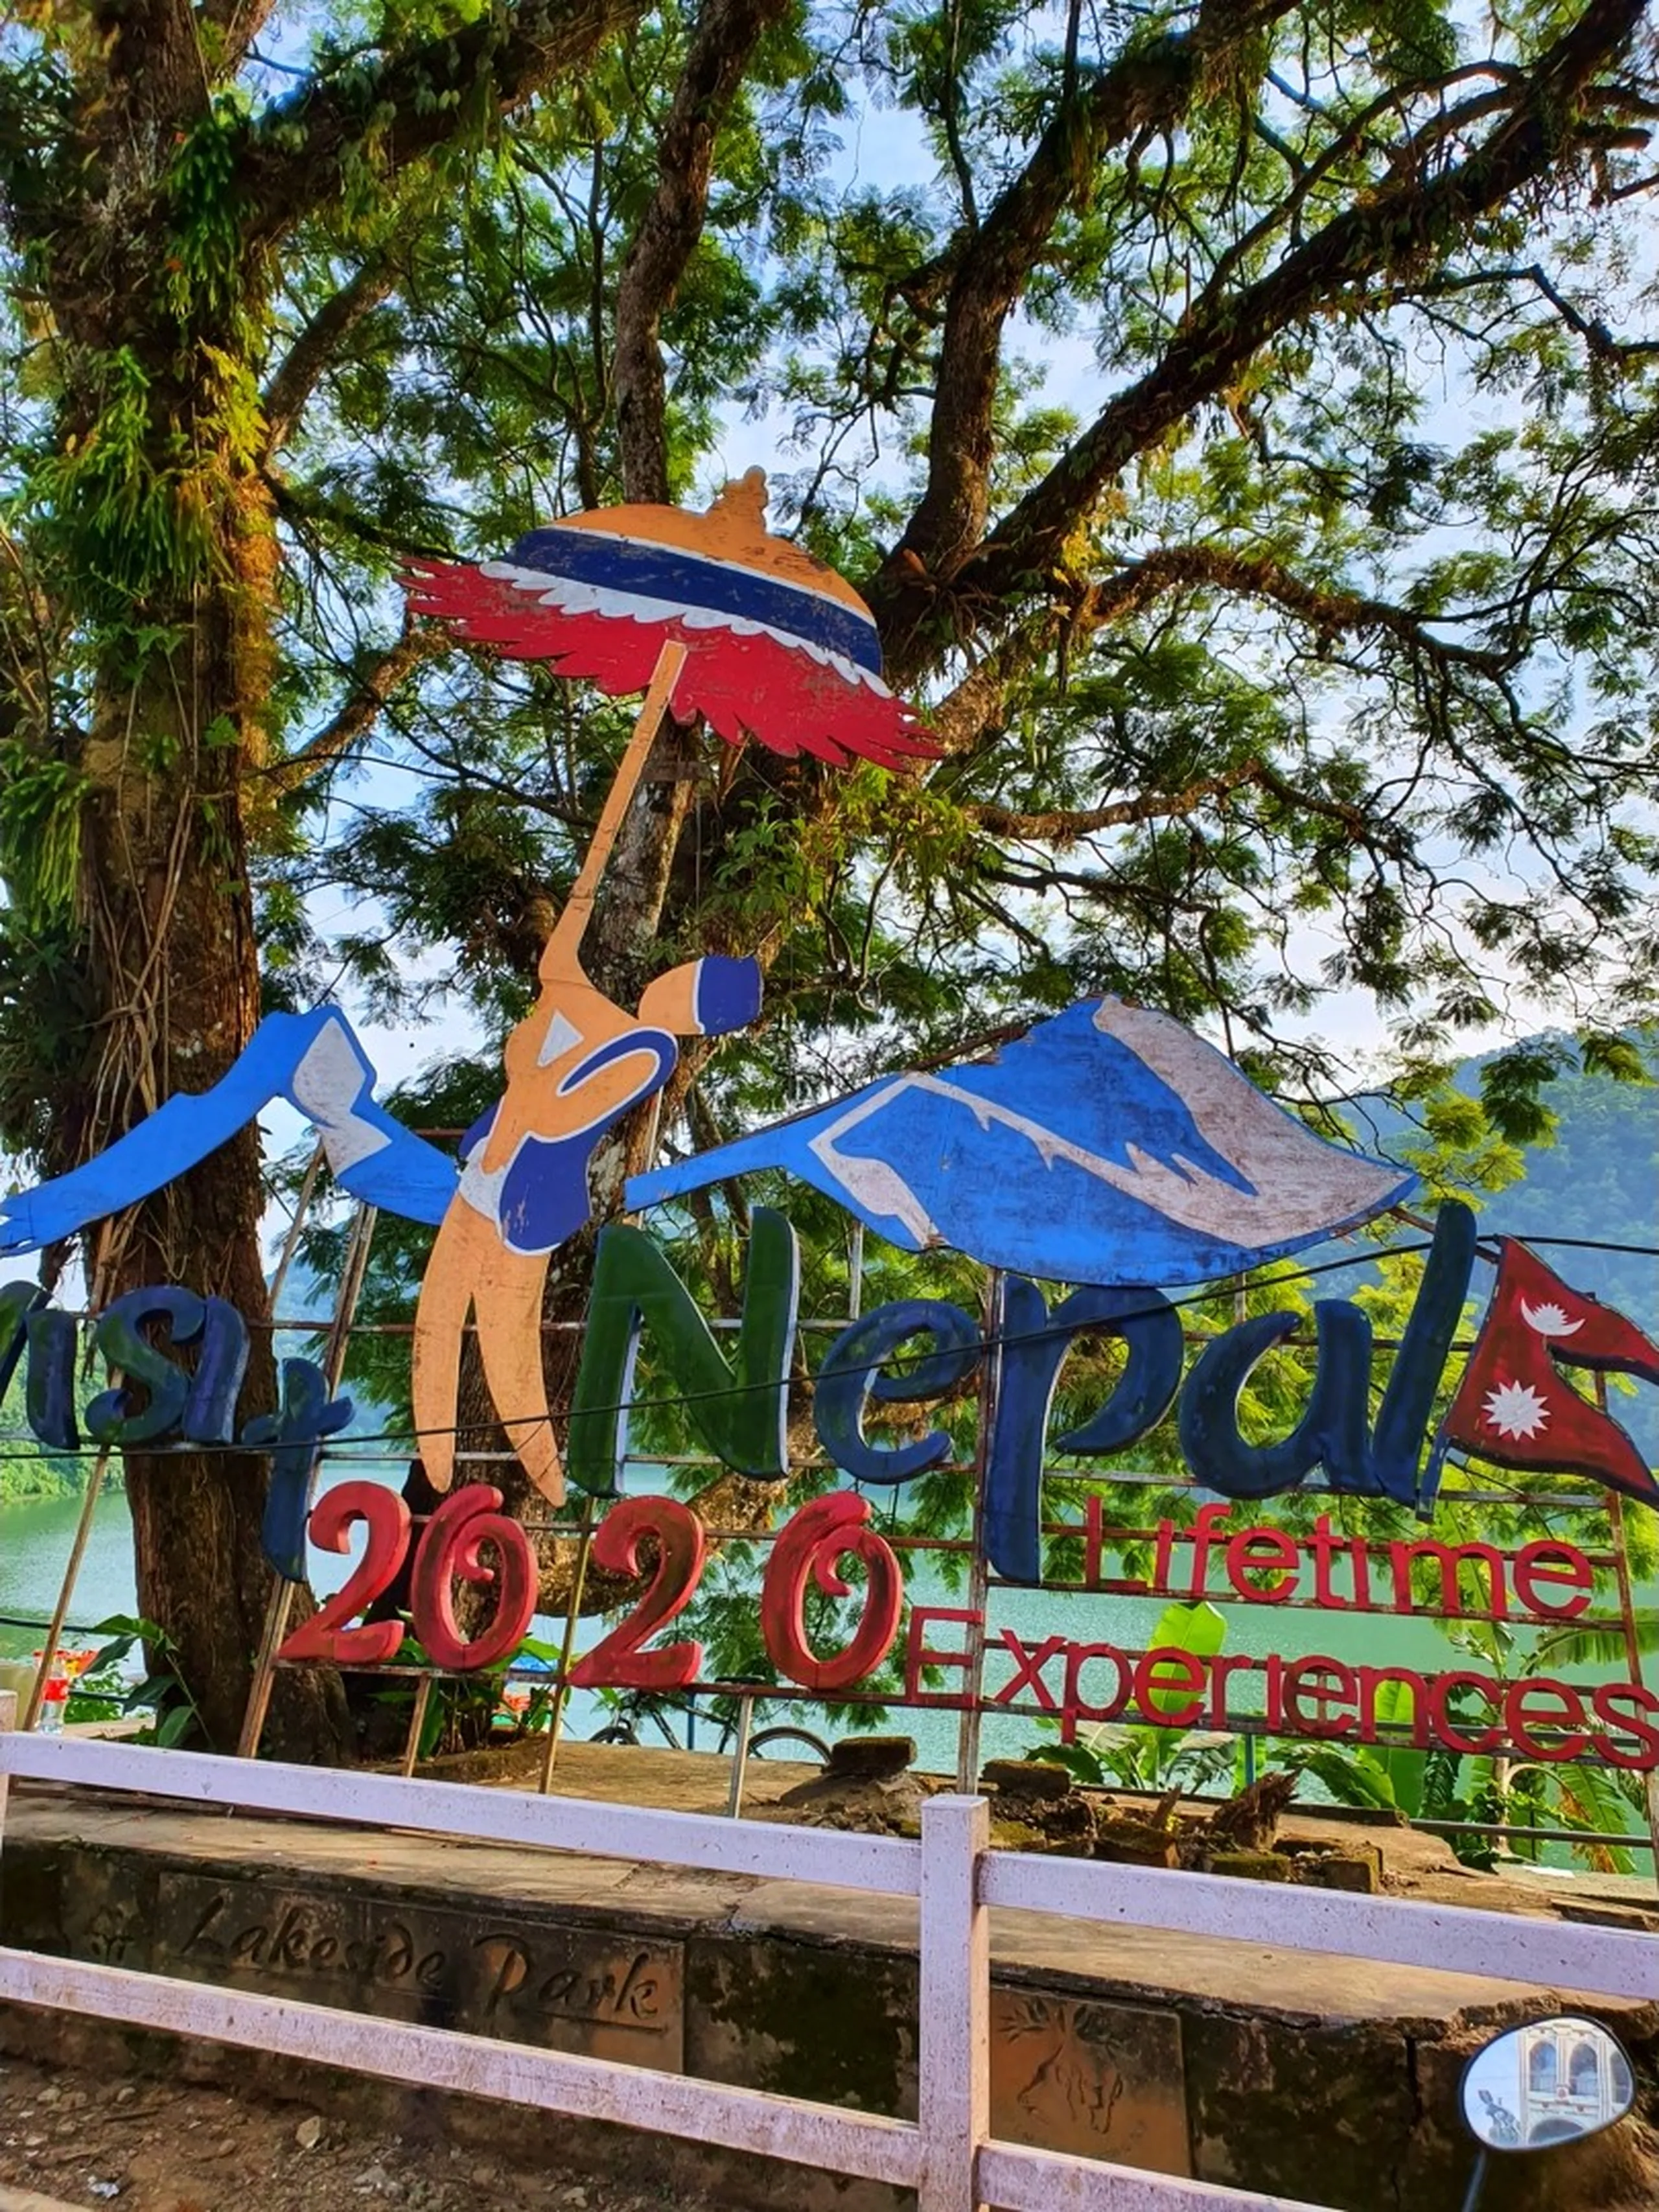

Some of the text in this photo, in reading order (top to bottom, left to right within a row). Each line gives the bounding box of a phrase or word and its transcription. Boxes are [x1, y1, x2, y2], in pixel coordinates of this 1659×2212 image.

[567, 1198, 1477, 1584] Nepal
[277, 1480, 902, 1690] 2020
[1086, 1495, 1595, 1619] Lifetime
[907, 1606, 1659, 1771] Experiences
[179, 1892, 658, 2021] Lakeside Park
